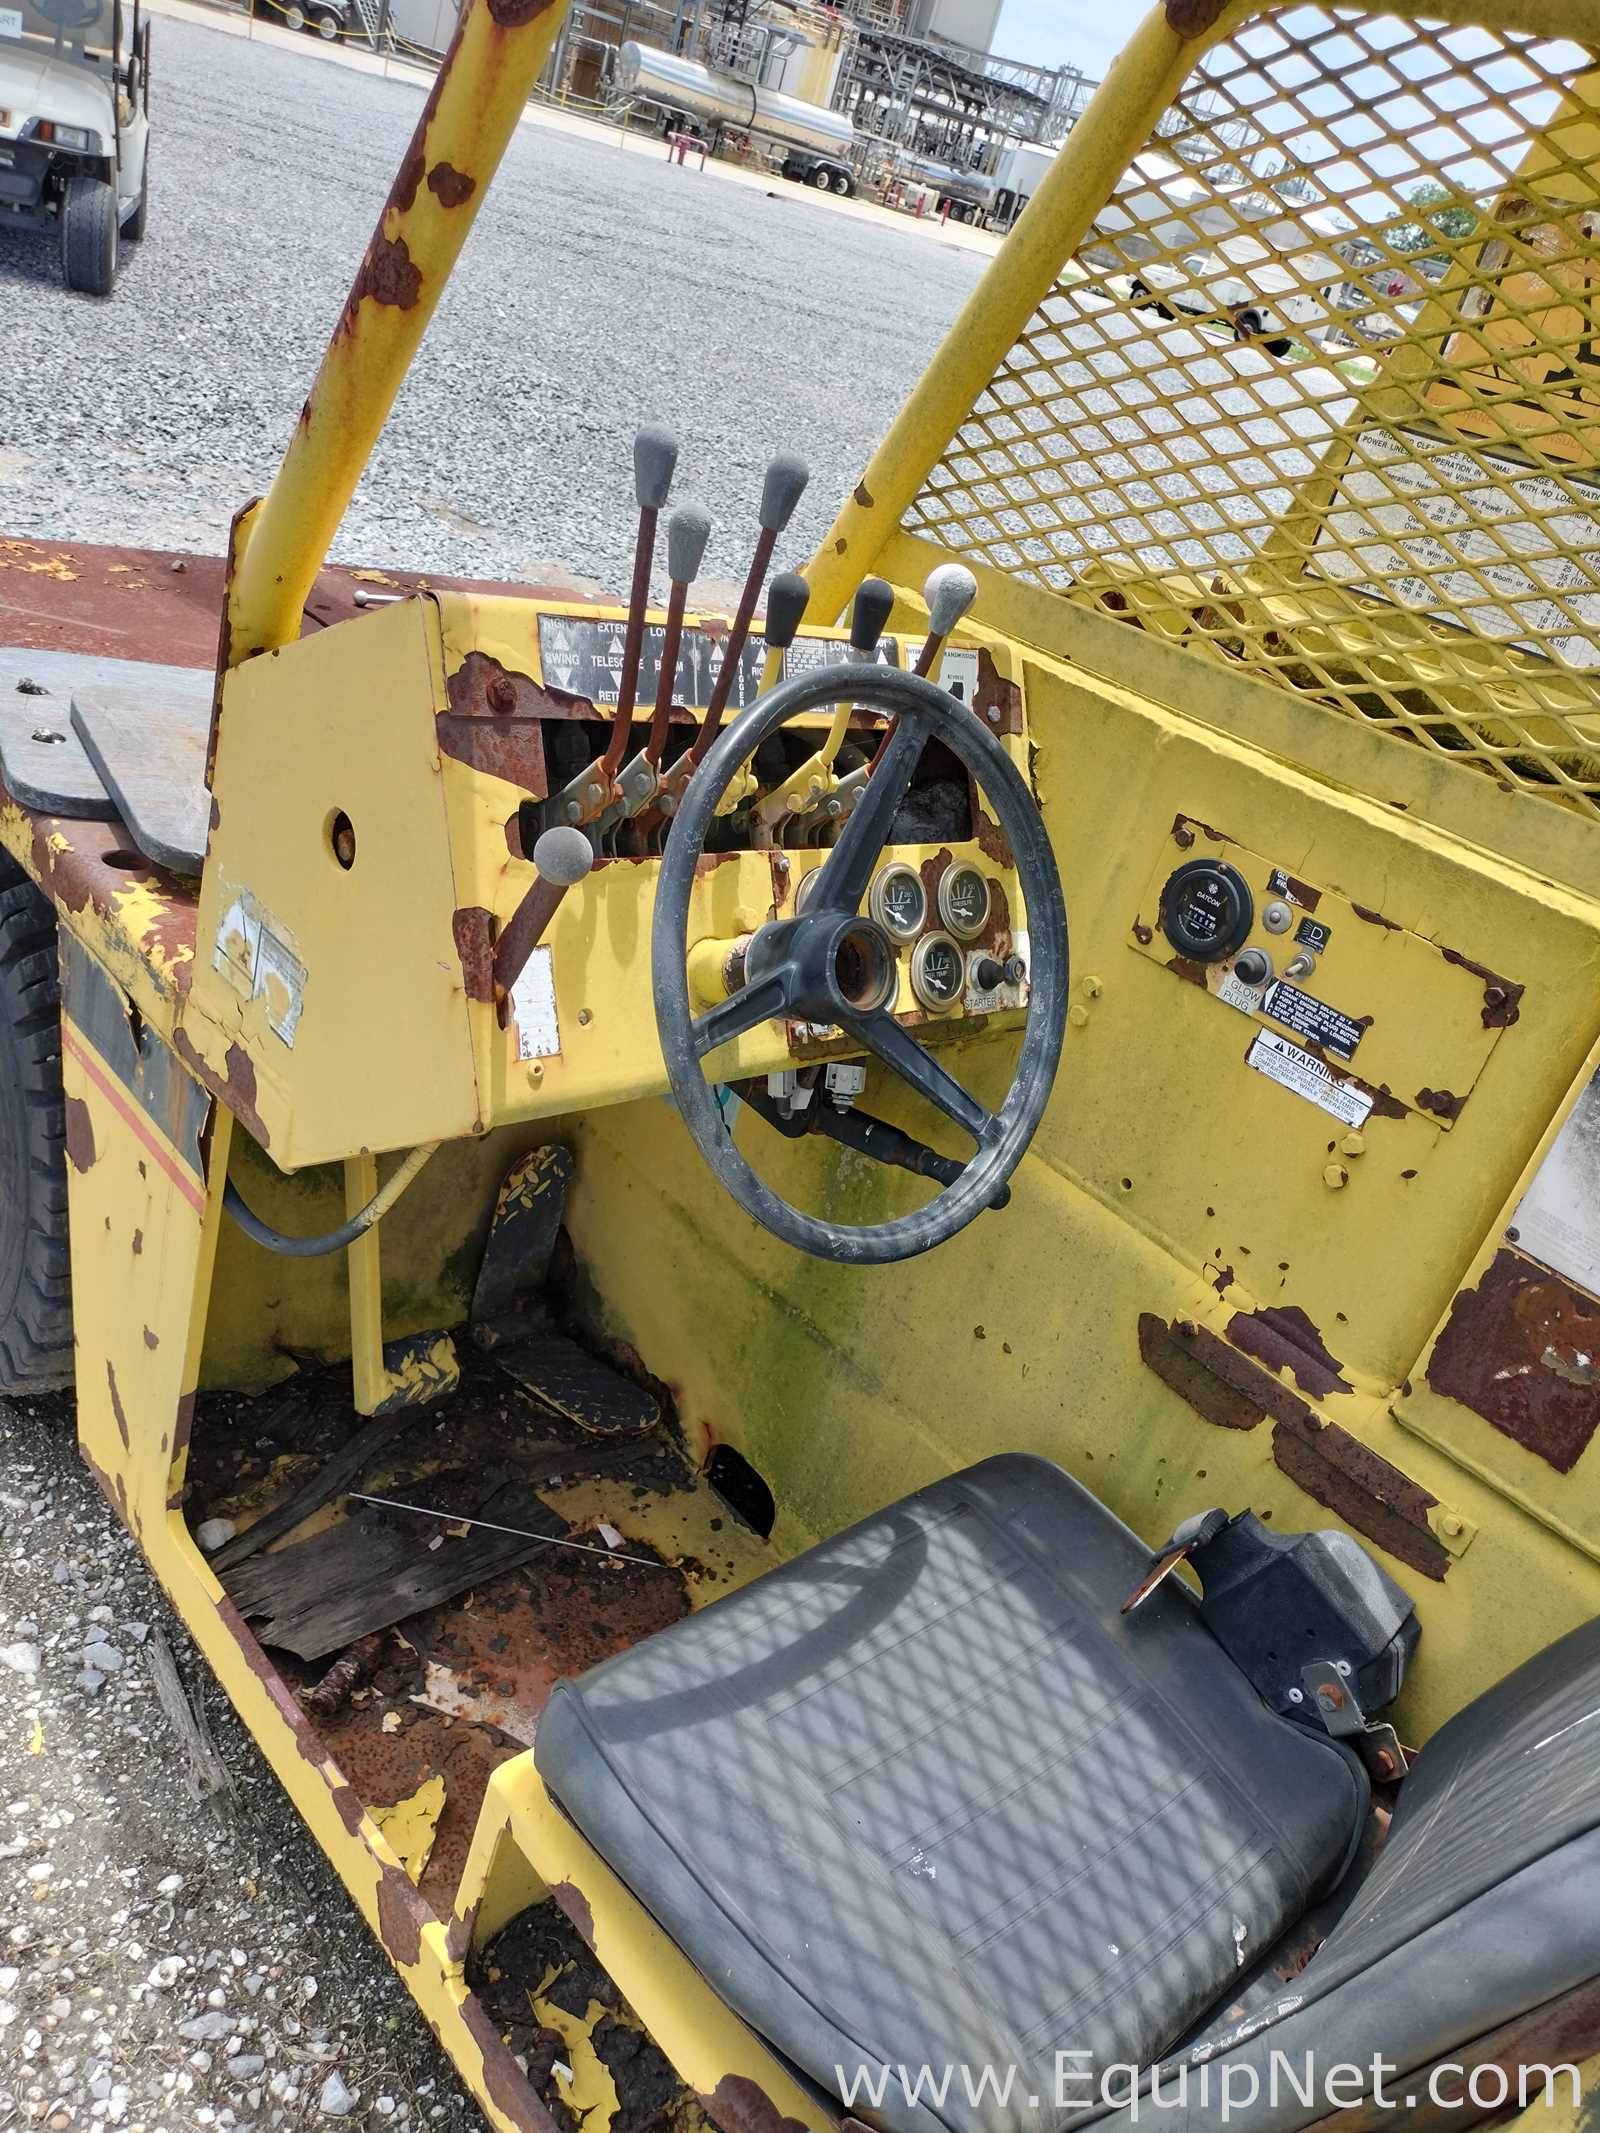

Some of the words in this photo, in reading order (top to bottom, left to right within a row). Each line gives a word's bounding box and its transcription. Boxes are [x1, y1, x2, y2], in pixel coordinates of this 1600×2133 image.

[1363, 435, 1387, 449] POWER
[1431, 456, 1472, 474] OPERATION
[1519, 482, 1538, 494] WITH
[1541, 489, 1553, 499] NO
[1492, 571, 1513, 585] Boom
[597, 622, 628, 634] EXTEN
[545, 653, 579, 666] SWING
[1196, 891, 1221, 908] DATCON
[1230, 979, 1261, 1002] GLOW
[964, 998, 996, 1009] STARTER
[1224, 990, 1249, 1012] PLUG
[1276, 999, 1287, 1009] FOR
[1281, 990, 1298, 1002] CRANK
[1318, 1010, 1330, 1020] FOR
[1284, 985, 1294, 994] FOR
[1295, 990, 1319, 1008] STARTING
[1319, 1005, 1338, 1018] BELOW
[1274, 1005, 1290, 1017] START
[1279, 995, 1293, 1006] PUSH
[1293, 1003, 1305, 1013] THIS
[1323, 1020, 1339, 1033] PLUG)
[1280, 1015, 1292, 1026] NOT
[1292, 1021, 1303, 1031] USE
[1320, 1095, 1355, 1119] OPERATING
